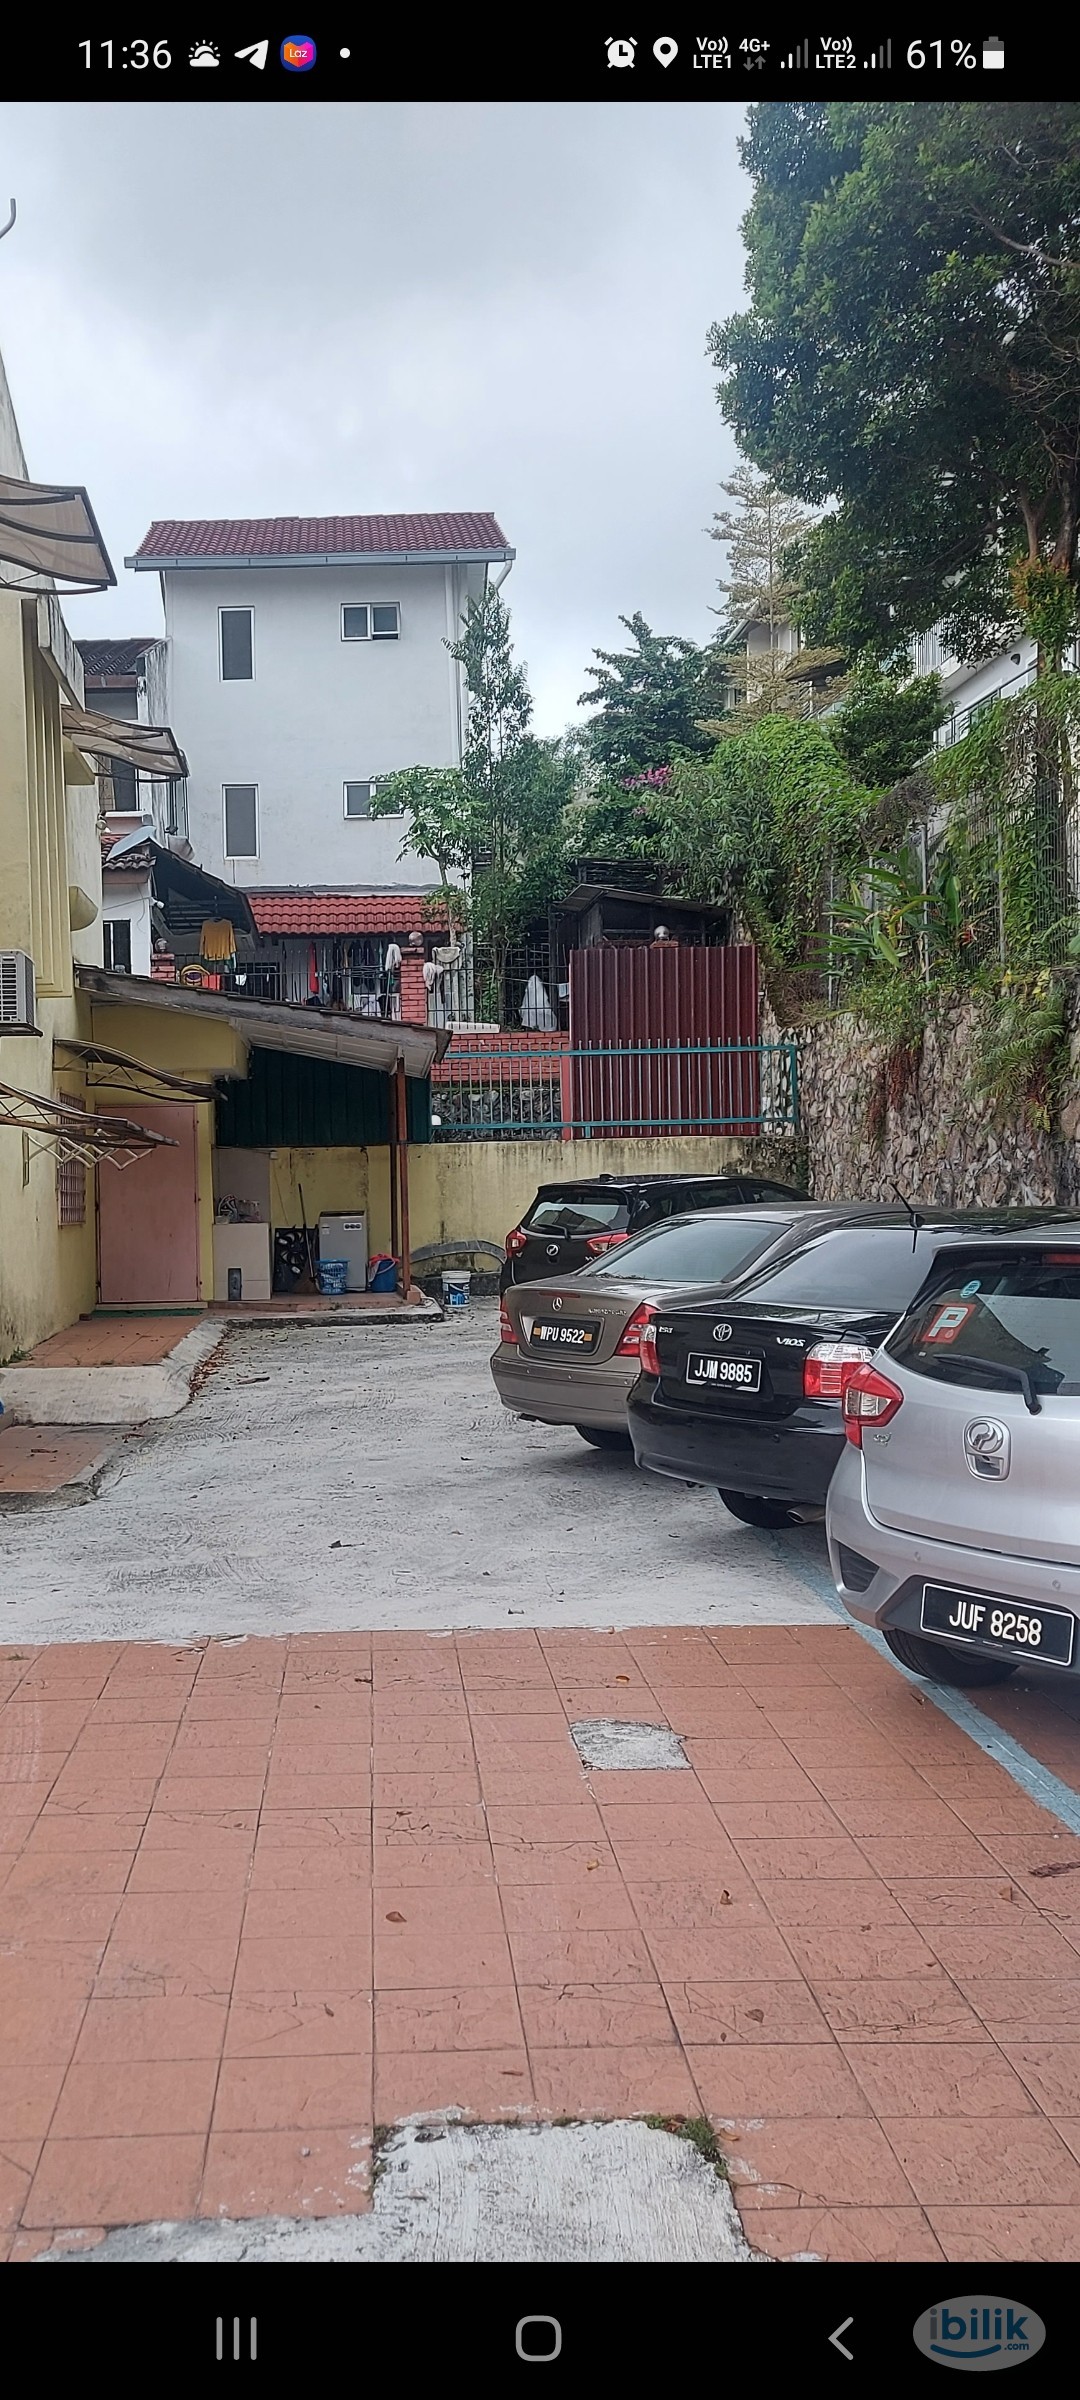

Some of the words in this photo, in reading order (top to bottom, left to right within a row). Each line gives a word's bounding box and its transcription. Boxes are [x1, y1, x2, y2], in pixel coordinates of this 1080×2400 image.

[540, 1325, 560, 1342] WPU
[559, 1328, 586, 1345] 9522
[927, 1306, 969, 1338] P
[694, 1358, 718, 1379] JJM
[719, 1361, 754, 1384] 9885
[948, 1600, 986, 1632] JUF
[990, 1609, 1043, 1646] 8258
